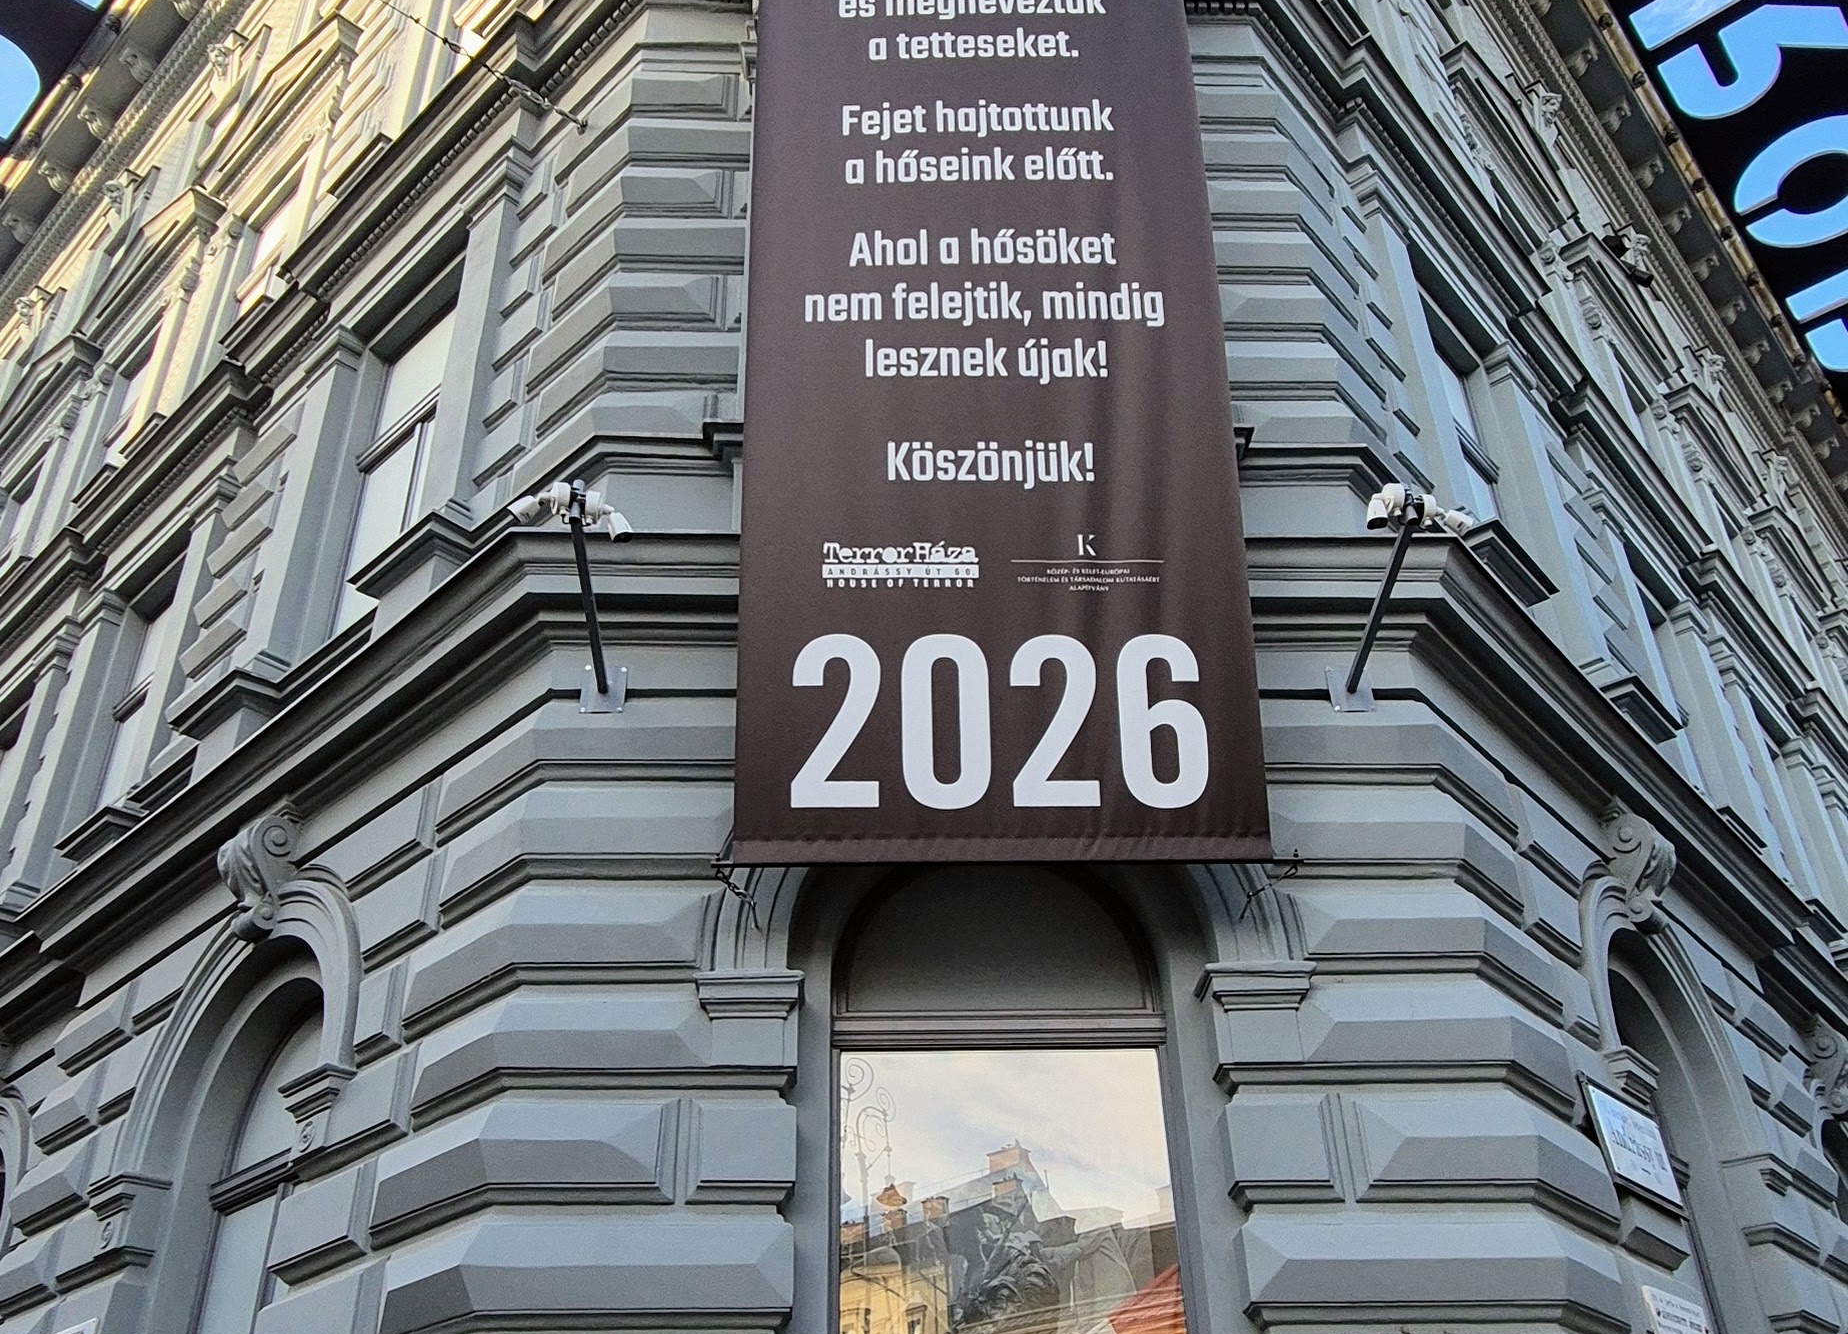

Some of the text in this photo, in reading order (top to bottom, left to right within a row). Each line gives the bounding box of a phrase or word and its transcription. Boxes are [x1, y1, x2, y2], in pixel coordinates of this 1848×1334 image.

[867, 27, 1080, 61] a tetteseket.
[841, 98, 1115, 141] Fejet hajtottunk
[844, 146, 1115, 185] a hőseink előtt.
[848, 227, 1117, 267] Ahol a hősöket
[804, 280, 1166, 327] nem felejtik, mindig
[865, 337, 1109, 385] lesznek újak!
[887, 439, 1095, 490] Köszönjük!
[1076, 534, 1097, 556] K
[826, 566, 913, 576] ANDRÁSSY
[925, 566, 943, 576] ÚT
[826, 579, 975, 588] HOUSE OF TERROR
[790, 633, 1210, 810] 2026
